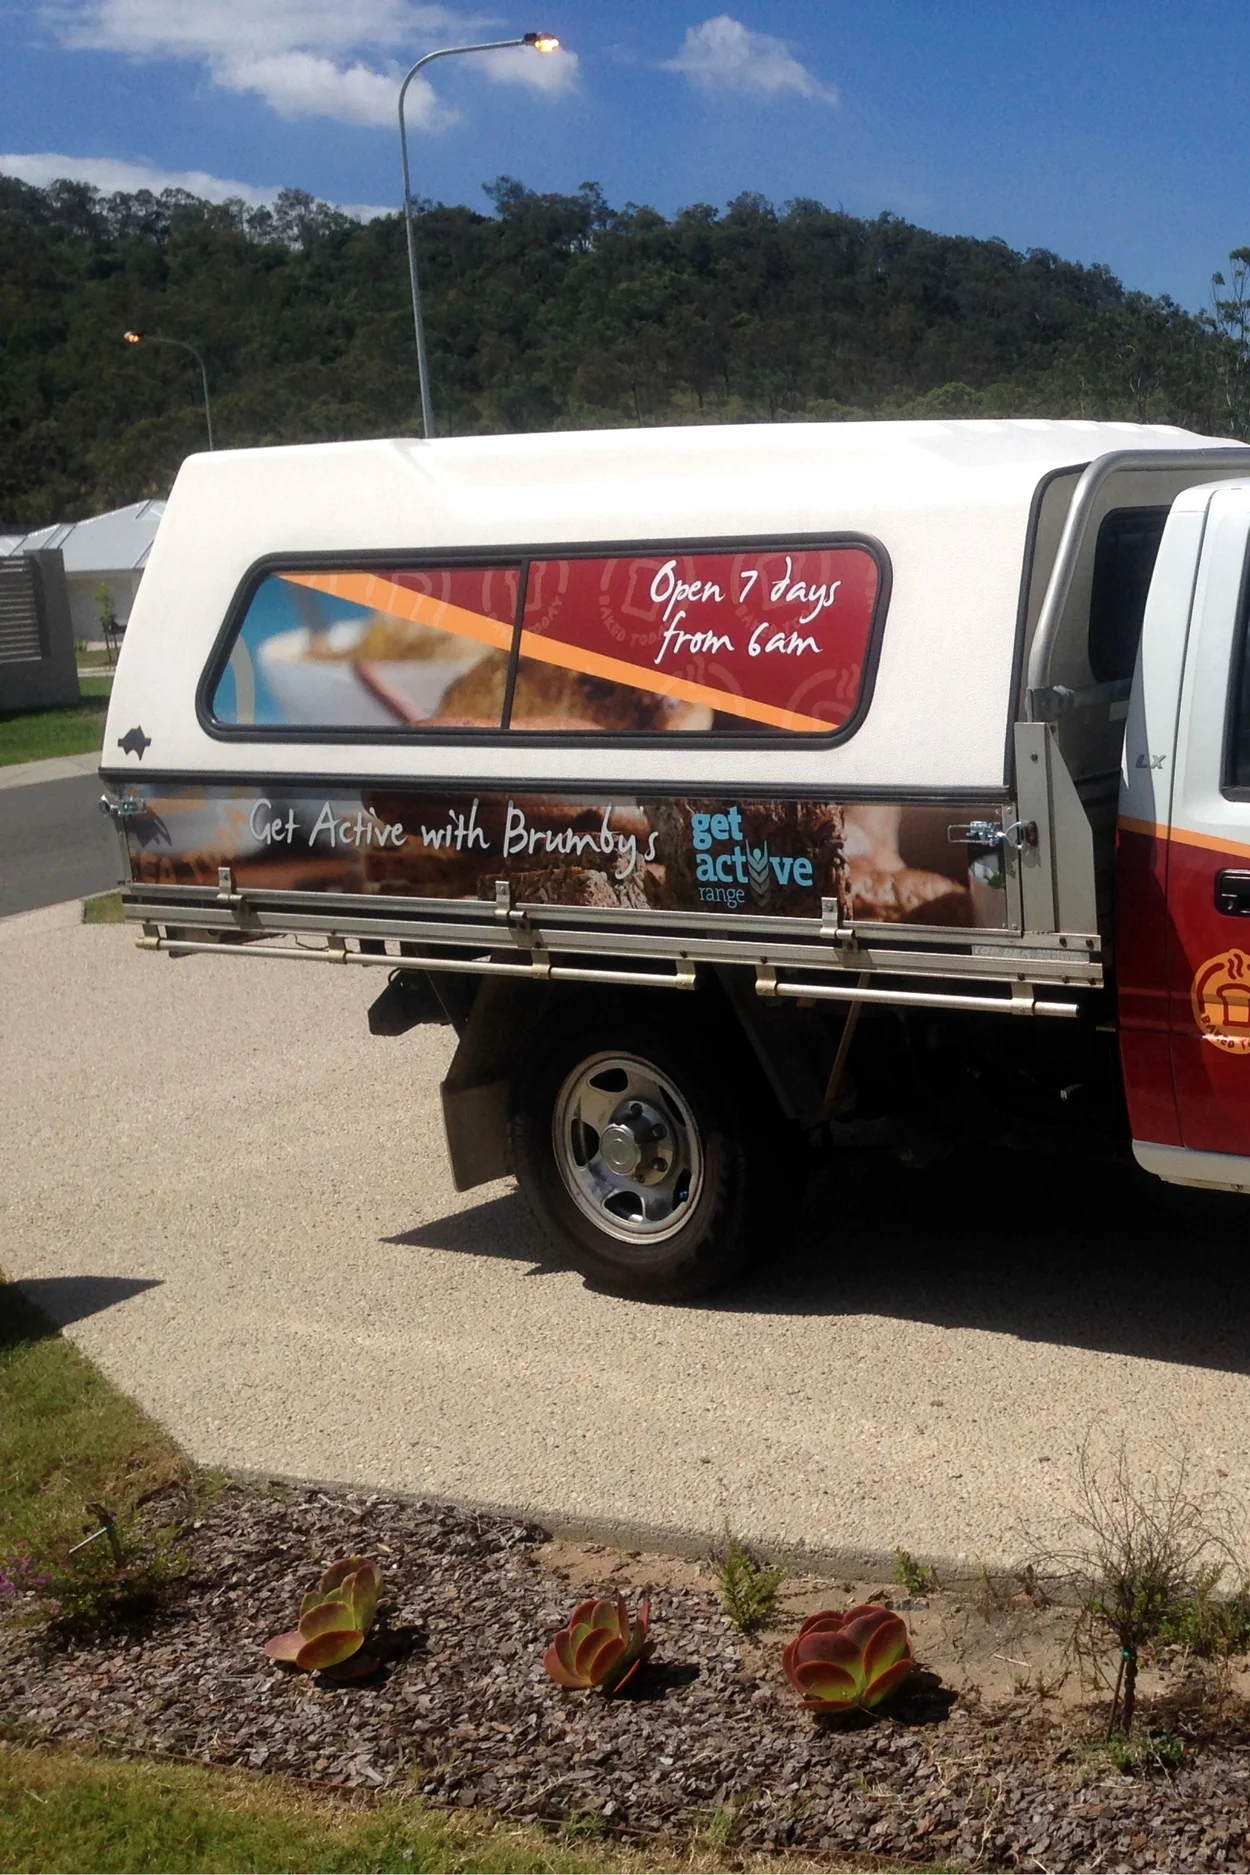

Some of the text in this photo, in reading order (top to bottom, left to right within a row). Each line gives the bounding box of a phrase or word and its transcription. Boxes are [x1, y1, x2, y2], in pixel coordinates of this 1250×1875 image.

[650, 560, 726, 622] Open
[739, 570, 759, 603] 7
[770, 556, 842, 624] days
[654, 610, 735, 664] from
[748, 622, 823, 657] 6am
[1135, 754, 1167, 770] LX
[250, 798, 301, 845] Get
[308, 801, 408, 847] Active
[421, 798, 490, 850] with
[691, 805, 743, 850] get
[699, 887, 745, 909] range
